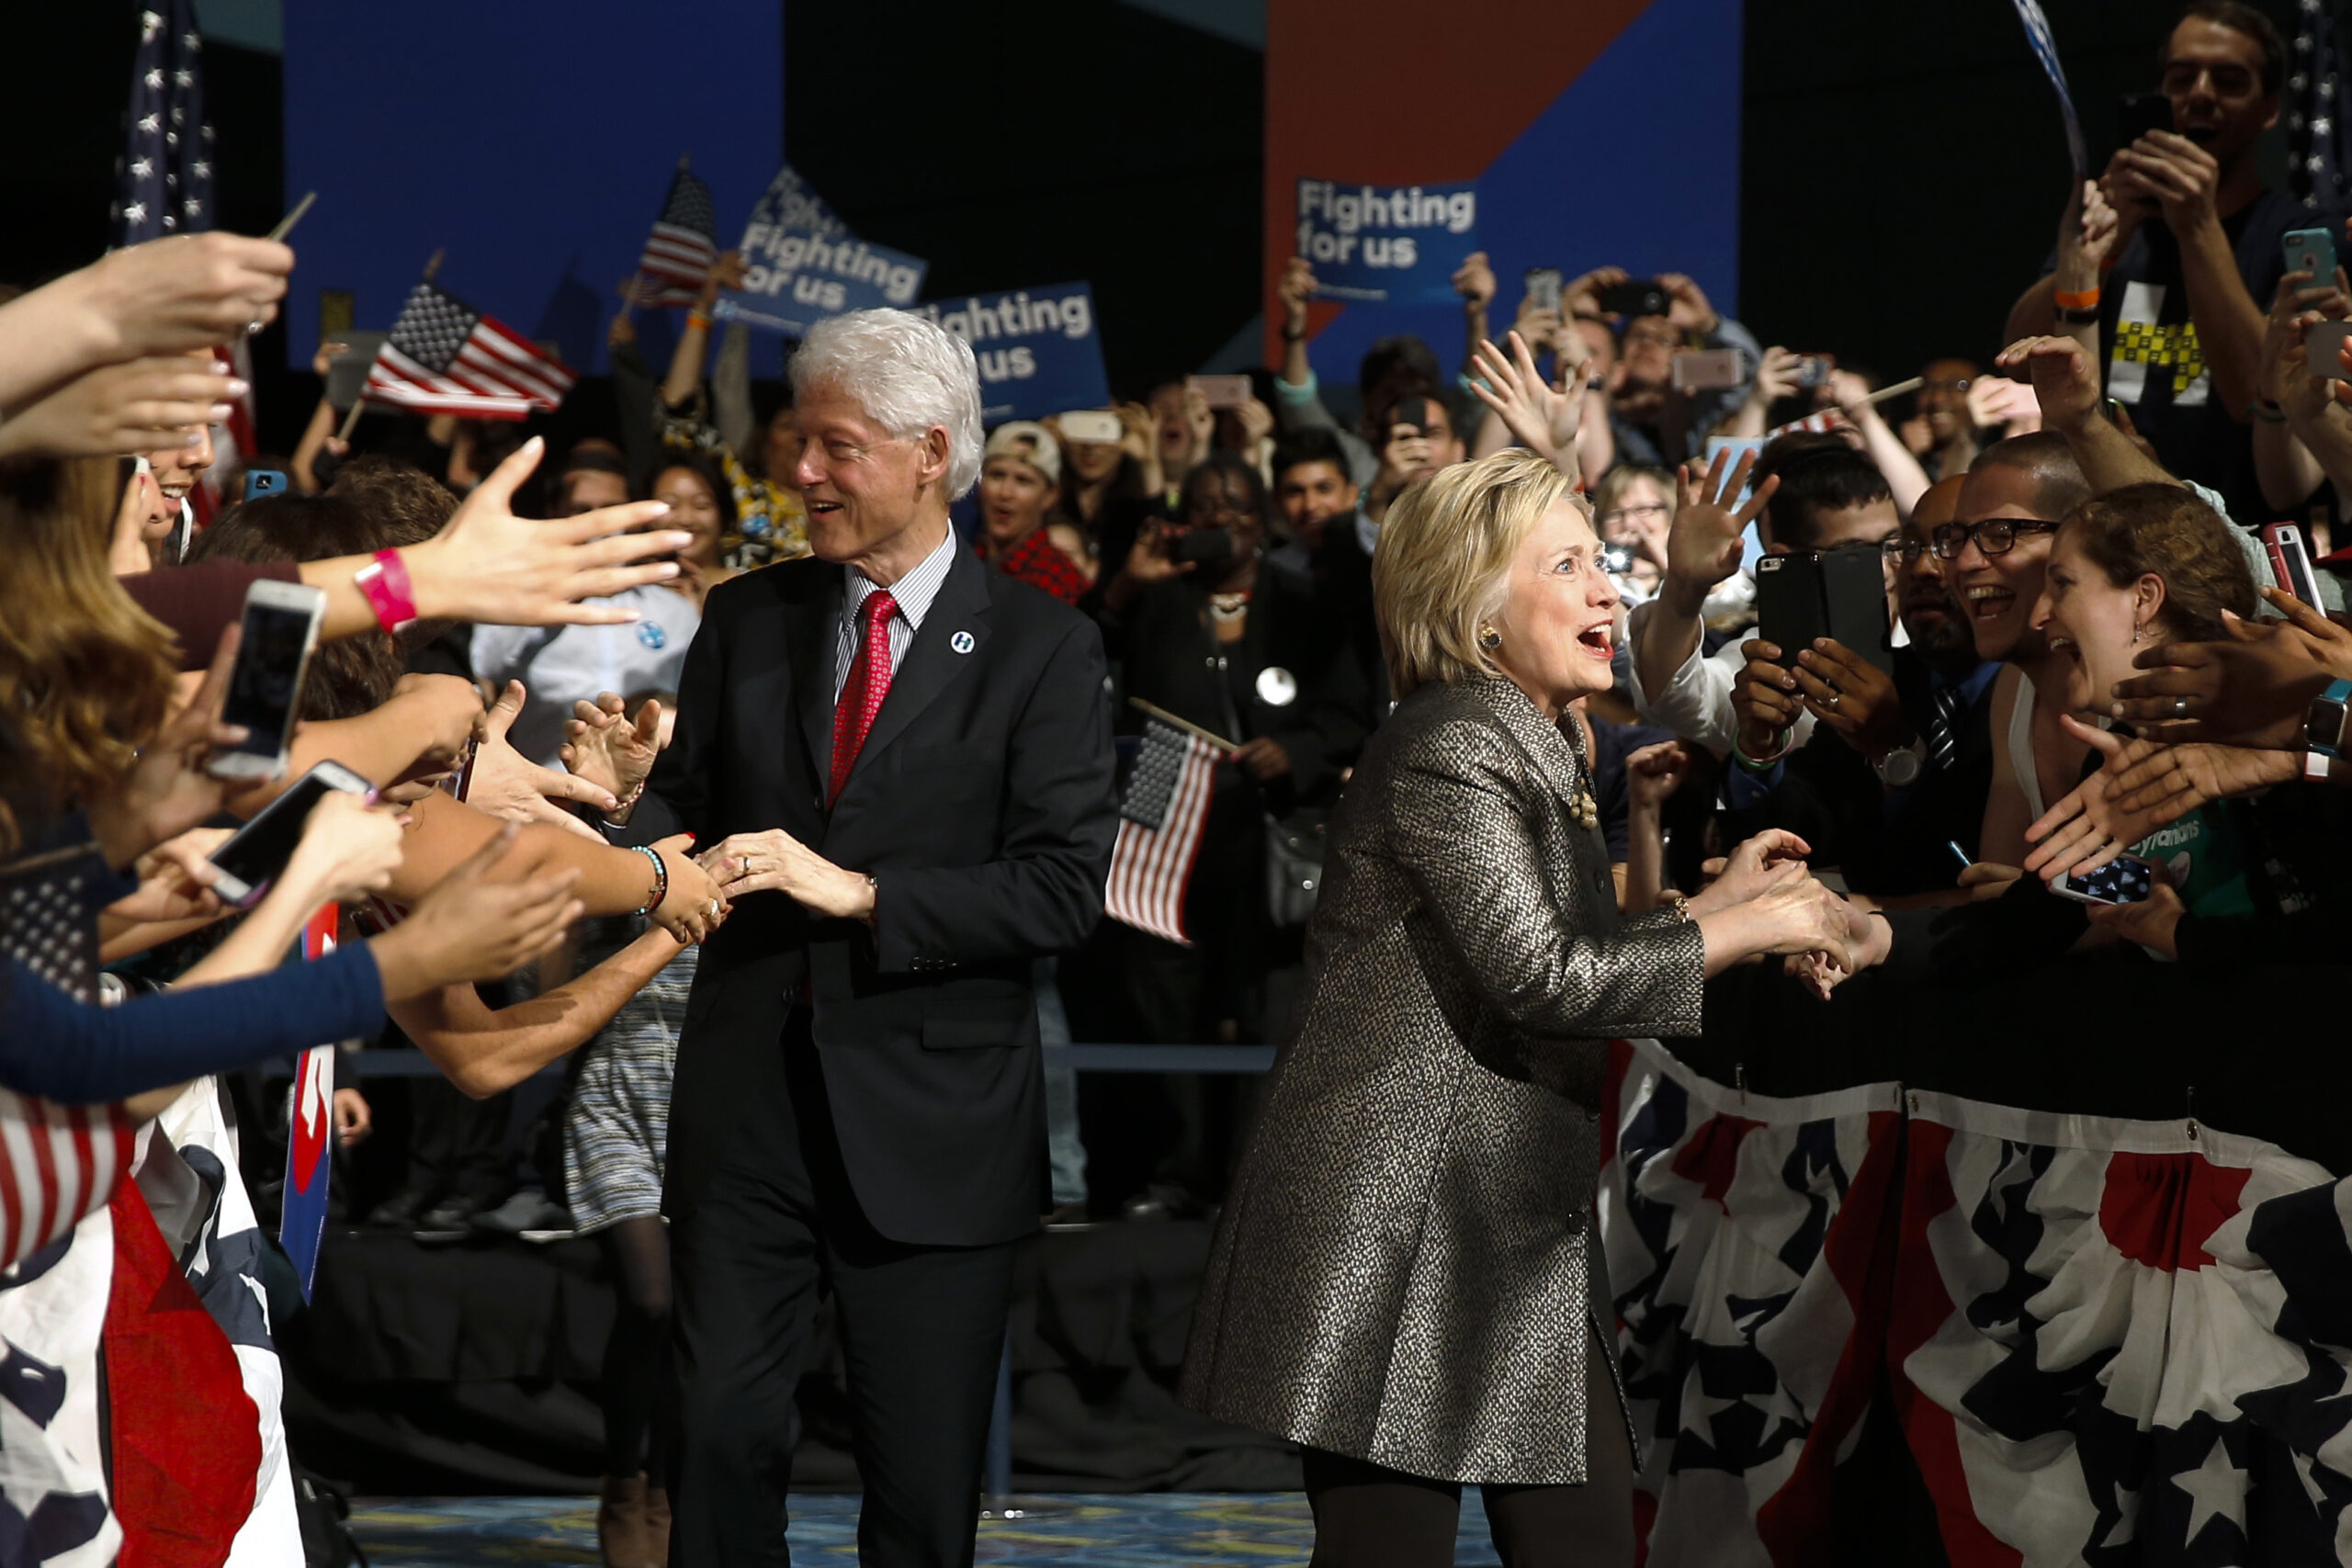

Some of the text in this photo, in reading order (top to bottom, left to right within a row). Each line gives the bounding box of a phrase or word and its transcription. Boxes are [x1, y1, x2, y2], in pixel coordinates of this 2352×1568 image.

[1298, 180, 1476, 234] Fighting
[741, 221, 920, 304] Fighting
[1298, 219, 1419, 268] for us
[739, 254, 847, 311] or us
[979, 346, 1037, 382] us
[954, 633, 972, 650] H
